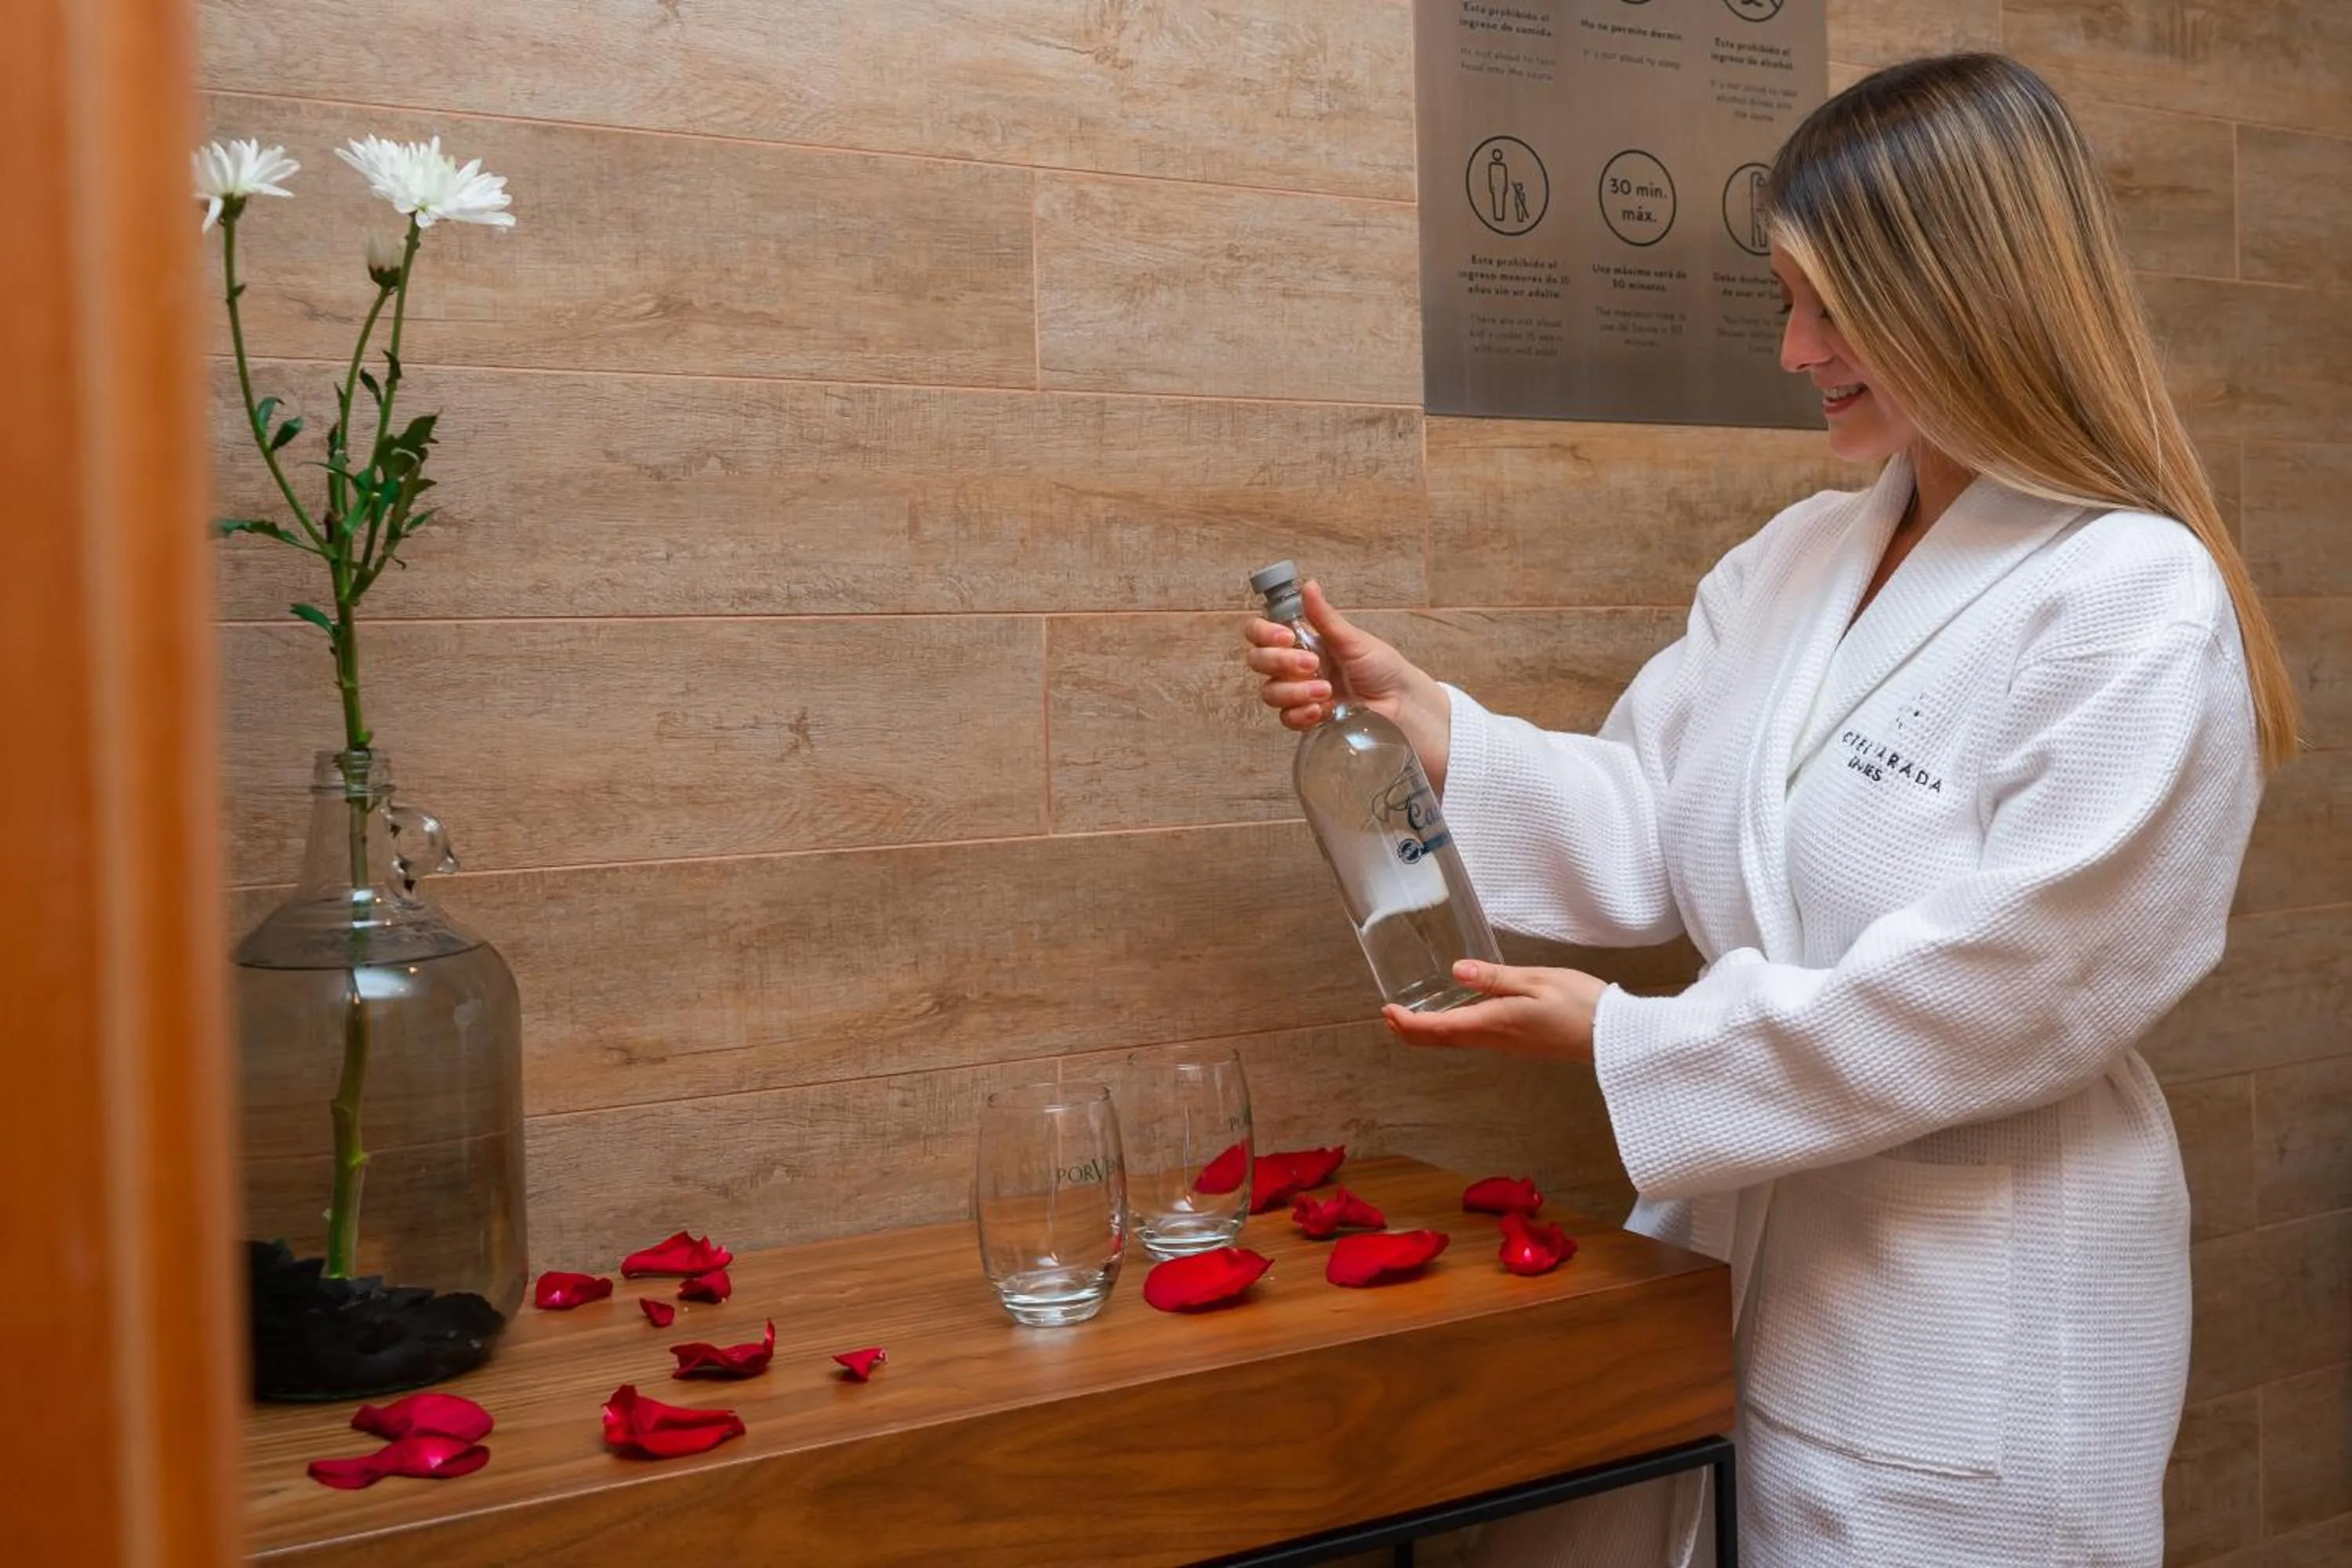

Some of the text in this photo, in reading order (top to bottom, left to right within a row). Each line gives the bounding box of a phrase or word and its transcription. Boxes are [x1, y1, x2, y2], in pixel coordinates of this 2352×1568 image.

[1610, 177, 1668, 198] 30 min.
[1622, 205, 1657, 223] máx.
